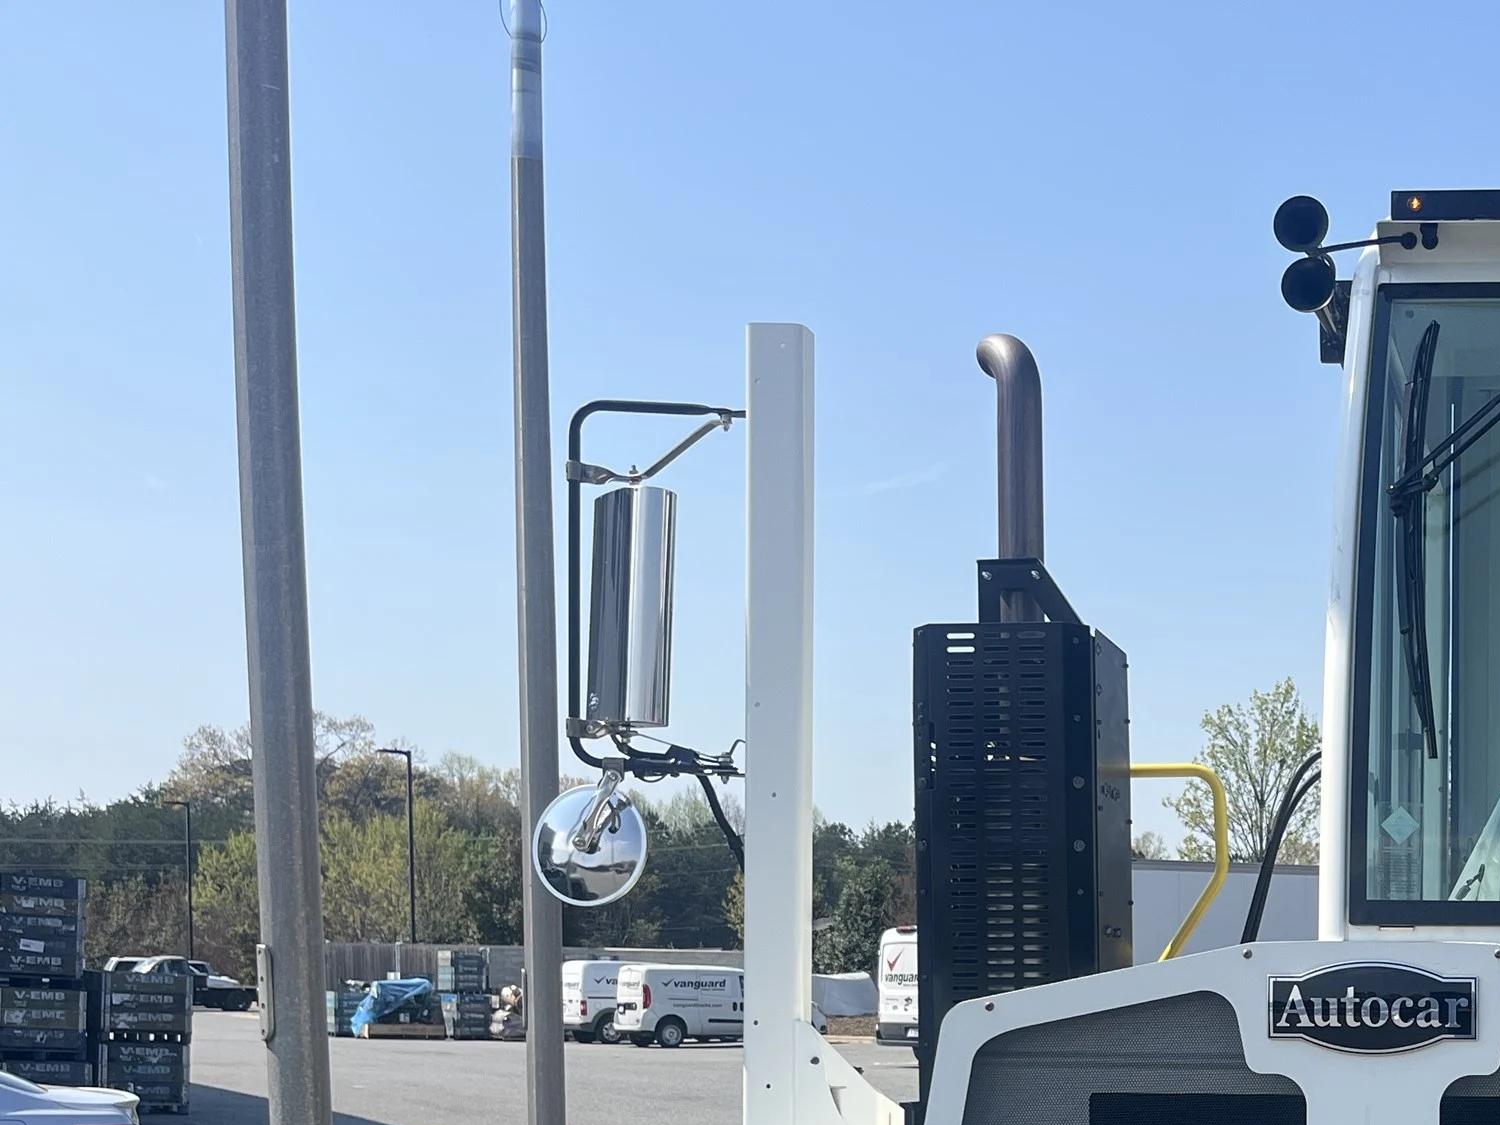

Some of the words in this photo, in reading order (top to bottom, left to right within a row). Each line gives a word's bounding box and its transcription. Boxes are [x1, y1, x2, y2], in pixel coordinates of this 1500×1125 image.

[673, 979, 726, 990] vanguard
[885, 973, 917, 985] vanguar
[1276, 983, 1469, 1029] Autocar
